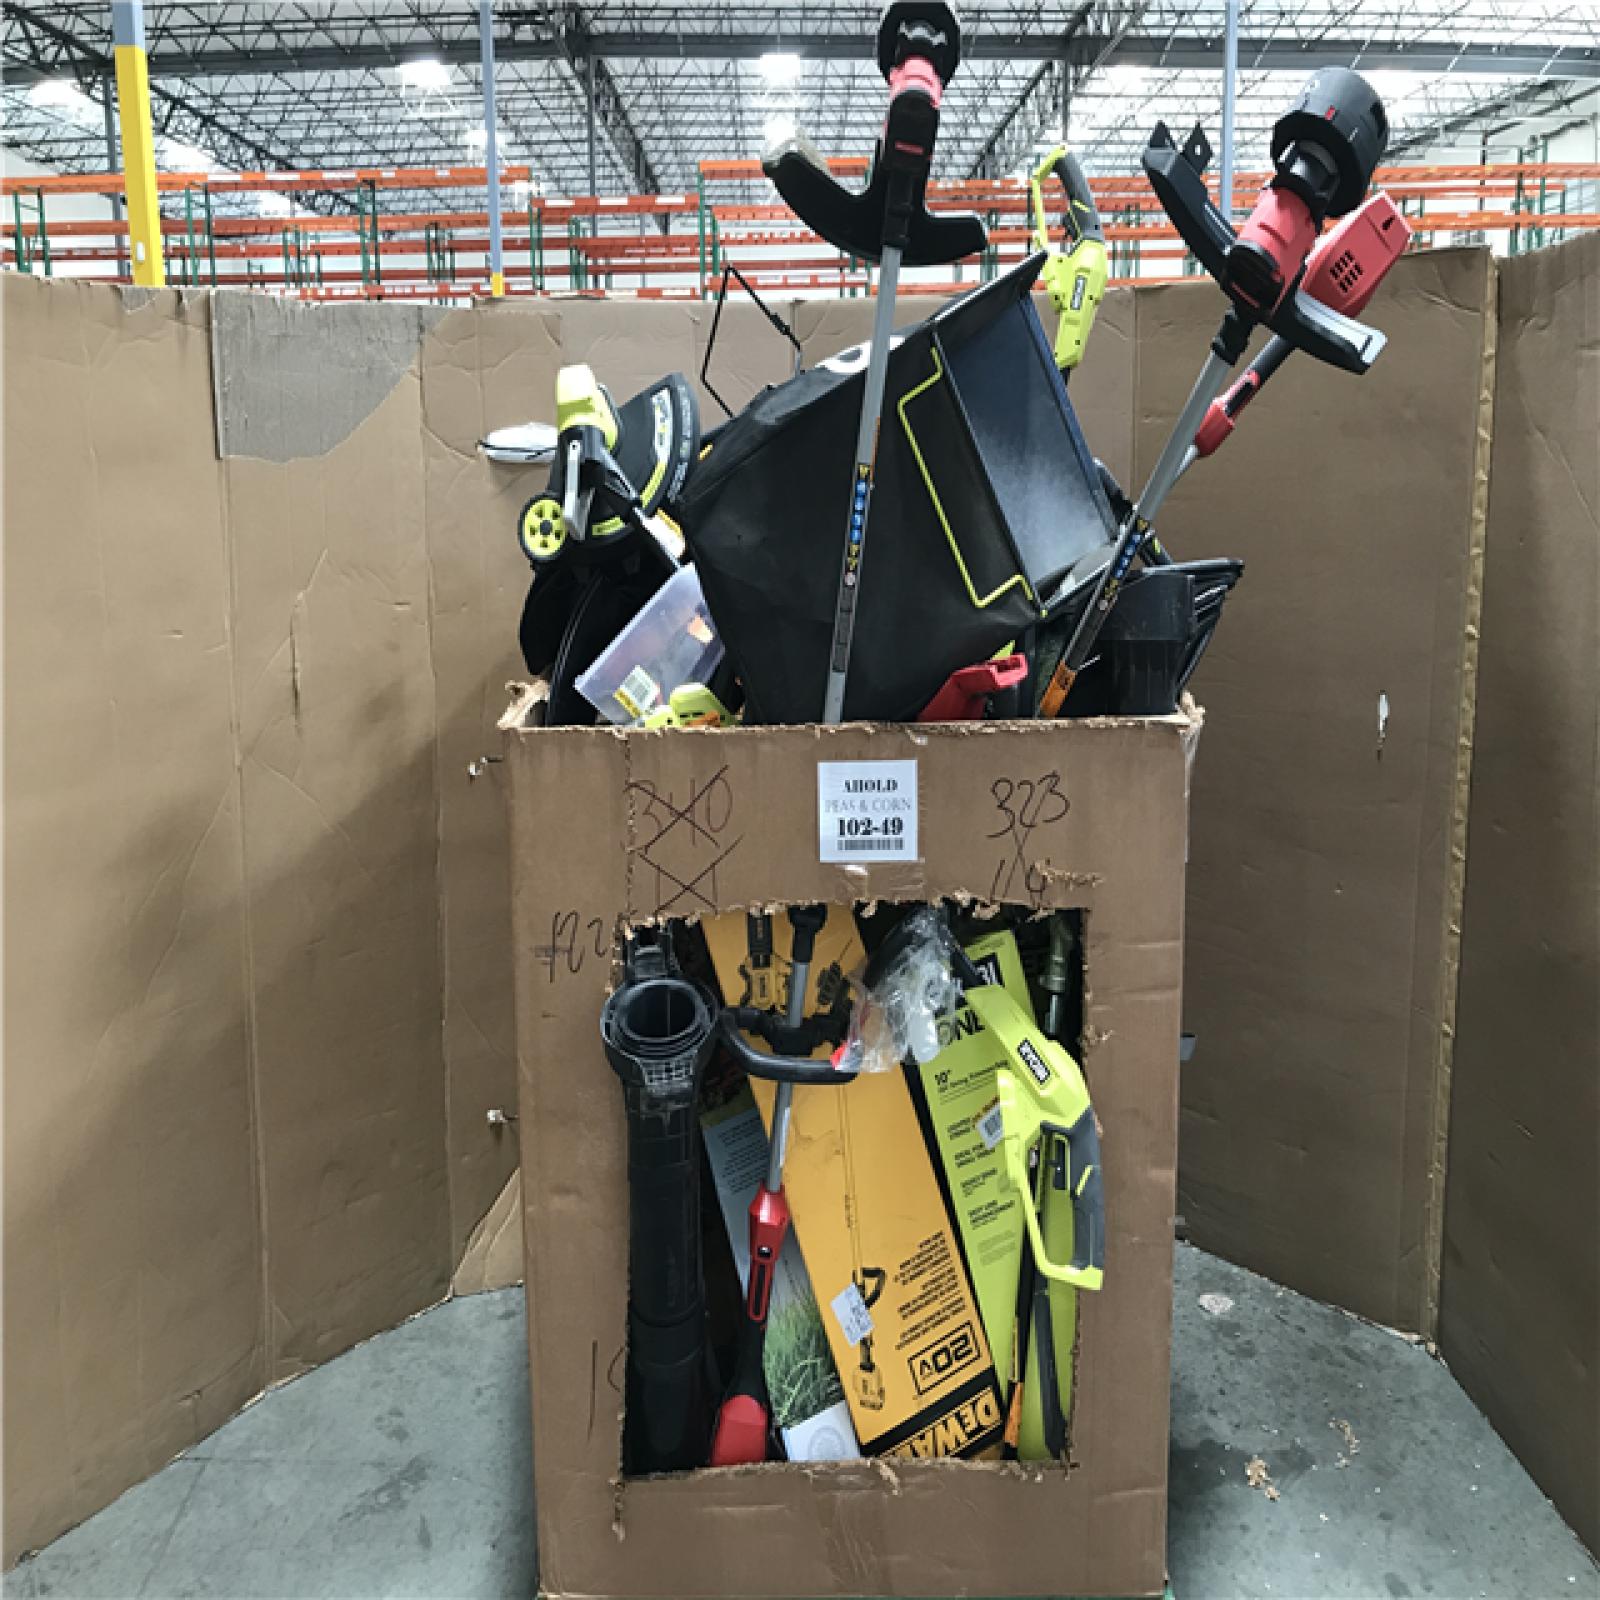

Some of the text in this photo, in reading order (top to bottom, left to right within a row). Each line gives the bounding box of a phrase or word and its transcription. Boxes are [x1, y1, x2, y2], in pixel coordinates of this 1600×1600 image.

[842, 778, 899, 793] AHOLD
[837, 817, 903, 836] 102-49
[919, 1332, 973, 1376] 20V
[892, 1391, 1000, 1457] DEWA
